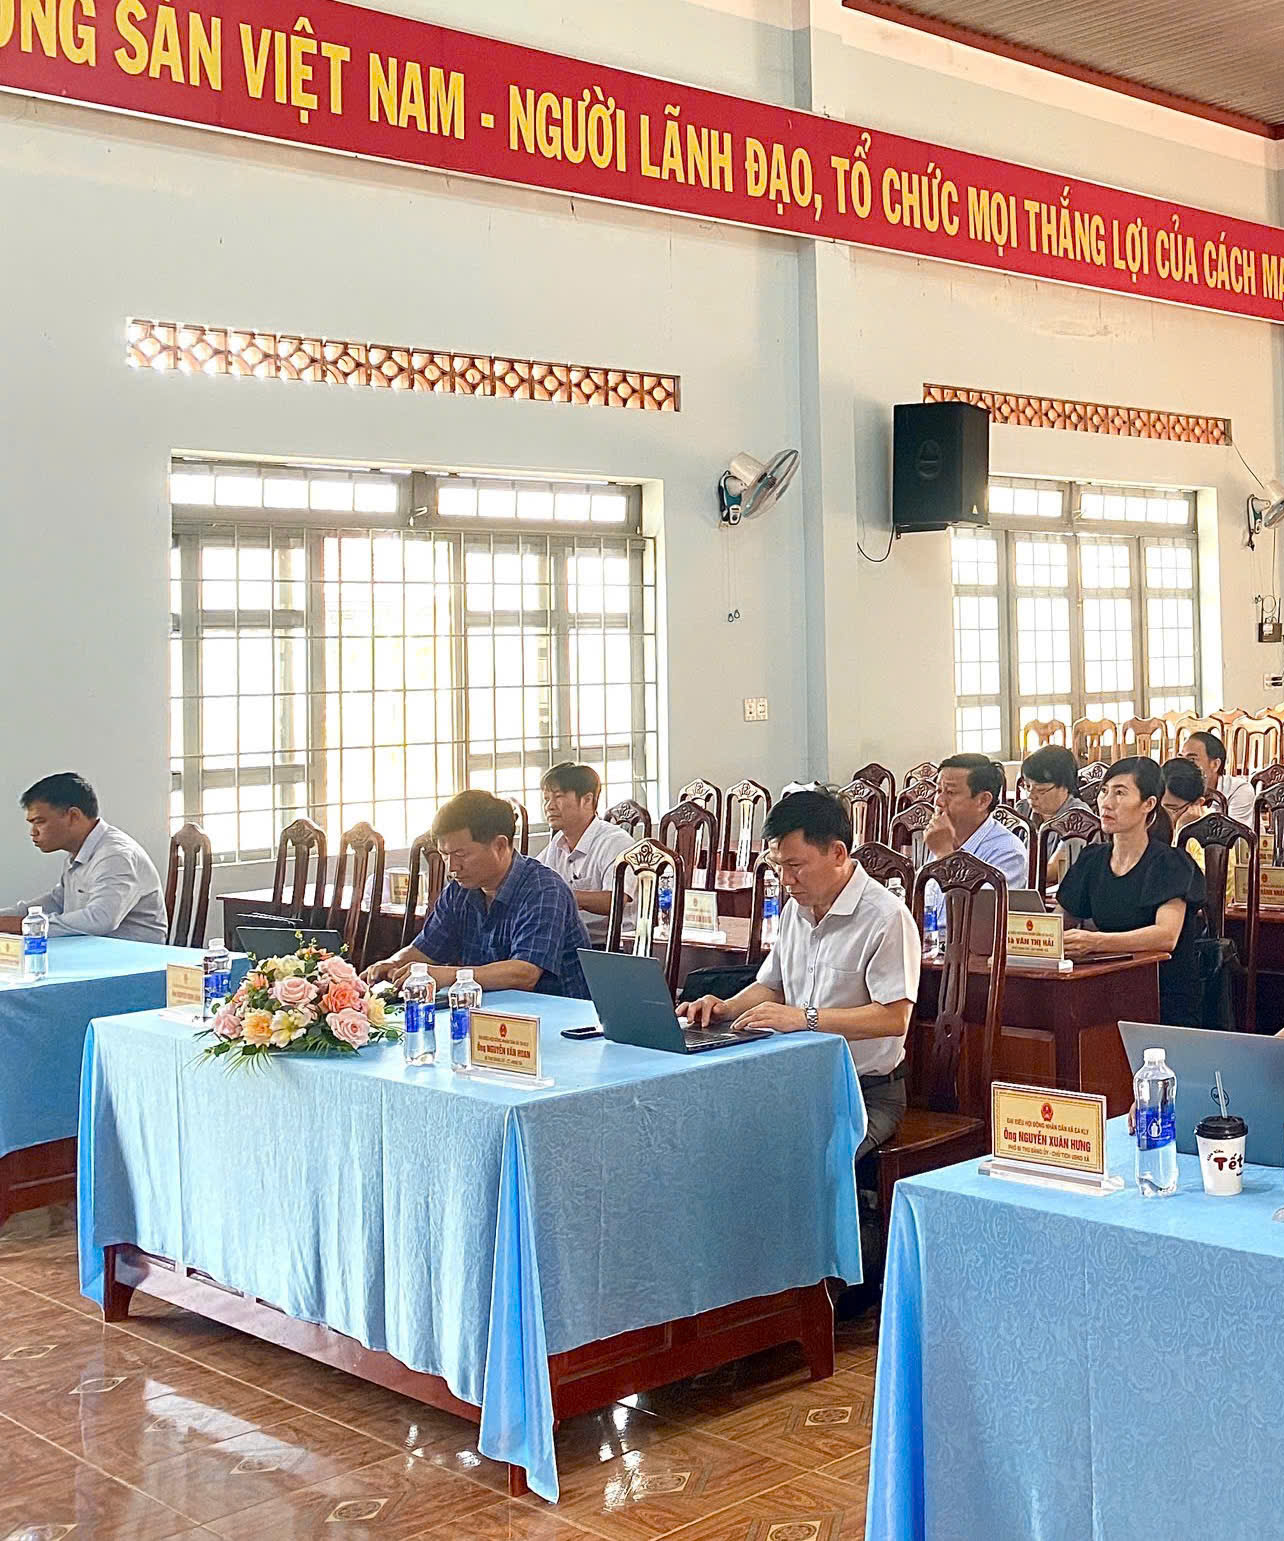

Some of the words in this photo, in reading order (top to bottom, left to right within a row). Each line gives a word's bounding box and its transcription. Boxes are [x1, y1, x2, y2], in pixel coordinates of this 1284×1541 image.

[239, 17, 350, 122] VIỆT
[369, 52, 465, 139] NAM
[509, 86, 626, 172] NGƯỜI
[640, 106, 733, 192] LÃNH
[745, 138, 822, 222] ĐẠO,
[831, 132, 872, 218] TỔ
[882, 162, 959, 237] CHỨC
[967, 187, 1016, 256] MỌI
[1024, 186, 1105, 262] THẮNG
[1113, 221, 1149, 283] LỢI
[1155, 212, 1198, 284] CỦA
[1204, 233, 1256, 295] CÁCH
[1003, 1127, 1017, 1143] Ông
[1019, 1130, 1048, 1146] NGUYỄN
[1049, 1134, 1070, 1150] XUÂN
[1213, 1153, 1244, 1171] Tết
